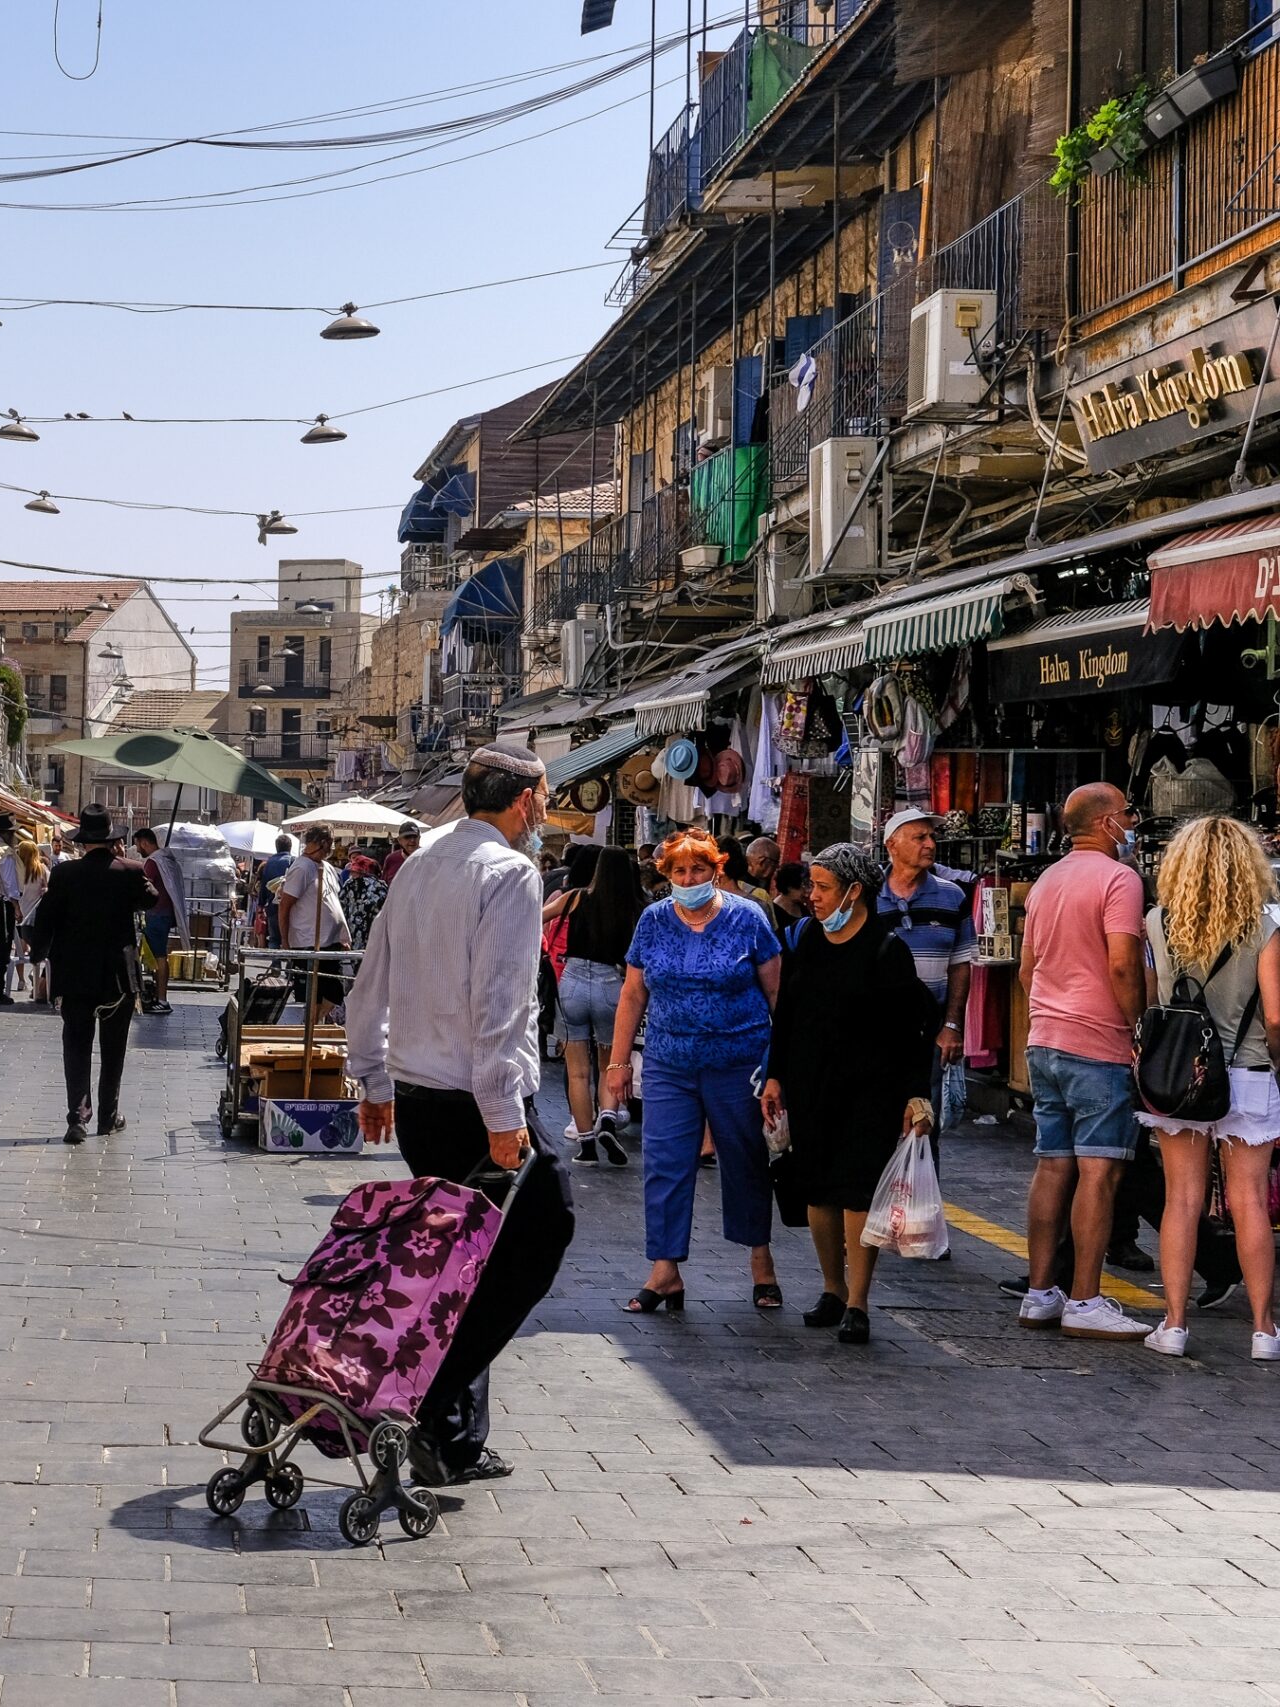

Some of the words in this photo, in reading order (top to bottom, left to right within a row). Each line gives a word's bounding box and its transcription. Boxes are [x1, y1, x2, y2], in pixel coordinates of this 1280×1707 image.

[1077, 382, 1143, 442] Halva
[1136, 347, 1252, 429] Kingdom
[1039, 653, 1070, 685] Halva
[1079, 644, 1128, 688] Kingdom
